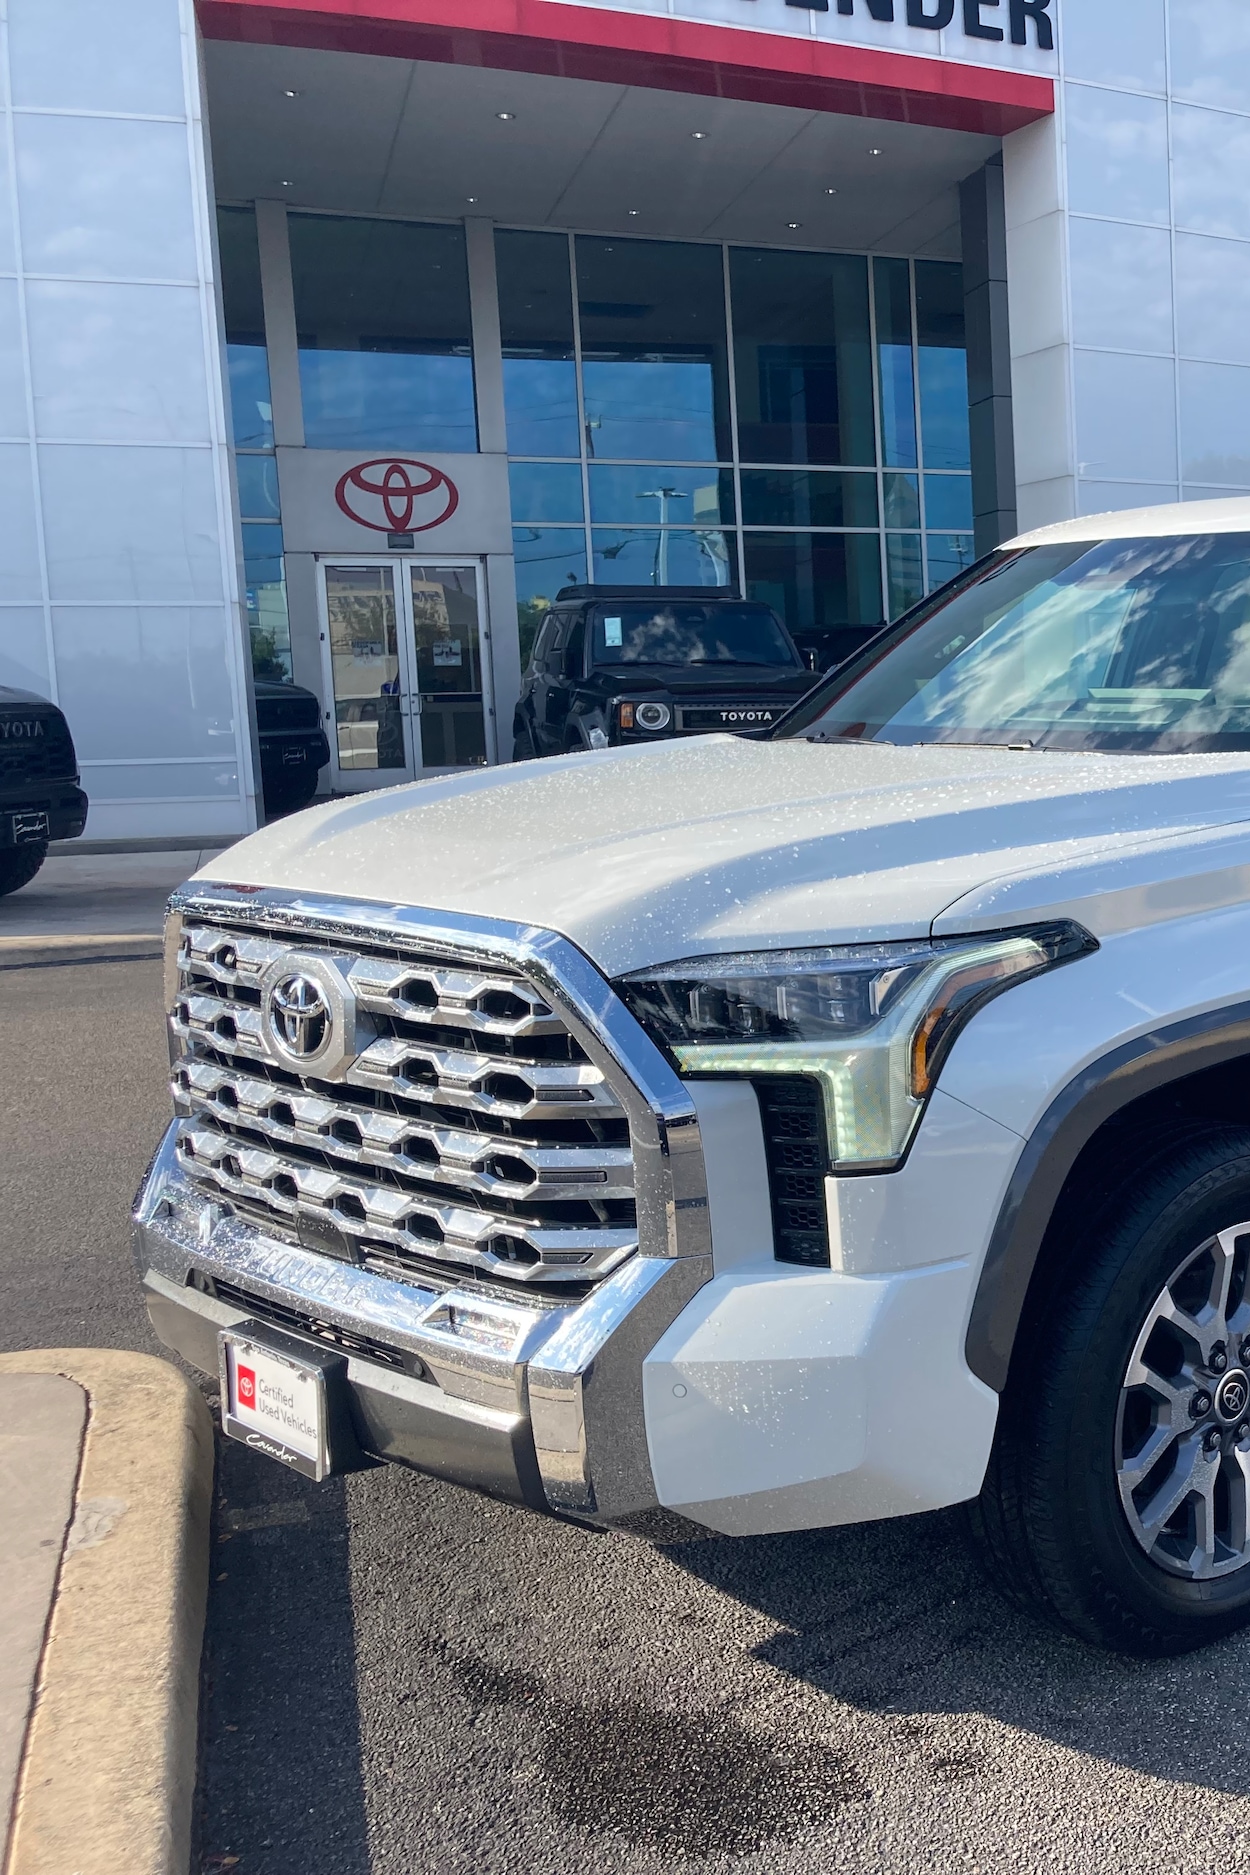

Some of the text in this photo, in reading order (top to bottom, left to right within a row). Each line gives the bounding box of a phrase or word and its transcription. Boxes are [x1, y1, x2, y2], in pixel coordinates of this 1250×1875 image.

[720, 711, 773, 721] TOYOTA
[258, 1379, 294, 1409] Certified
[258, 1398, 318, 1440] Used Vehicles
